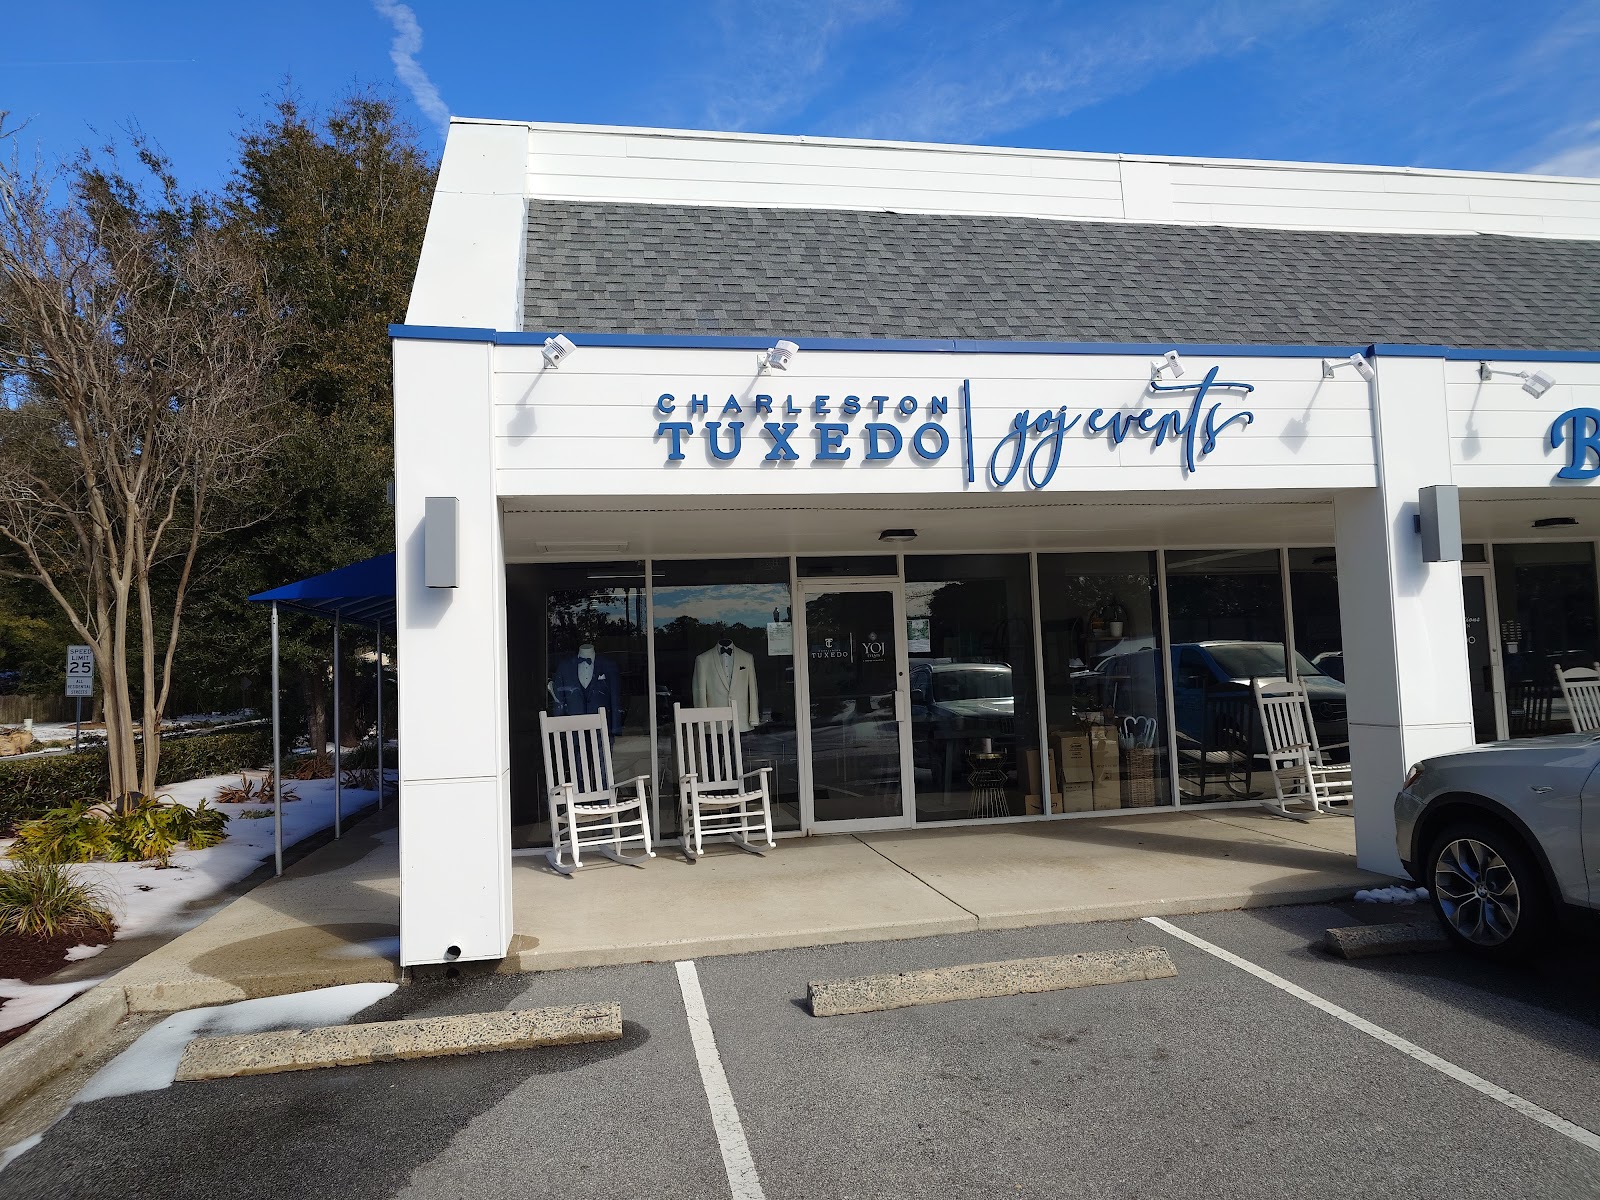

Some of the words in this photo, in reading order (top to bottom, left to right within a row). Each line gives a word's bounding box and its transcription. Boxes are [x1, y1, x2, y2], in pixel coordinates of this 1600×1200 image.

[657, 393, 948, 415] CHARLESTON
[1088, 366, 1255, 473] events
[657, 421, 950, 461] TUXEDO
[862, 643, 884, 655] YOJ
[70, 662, 91, 673] 25
